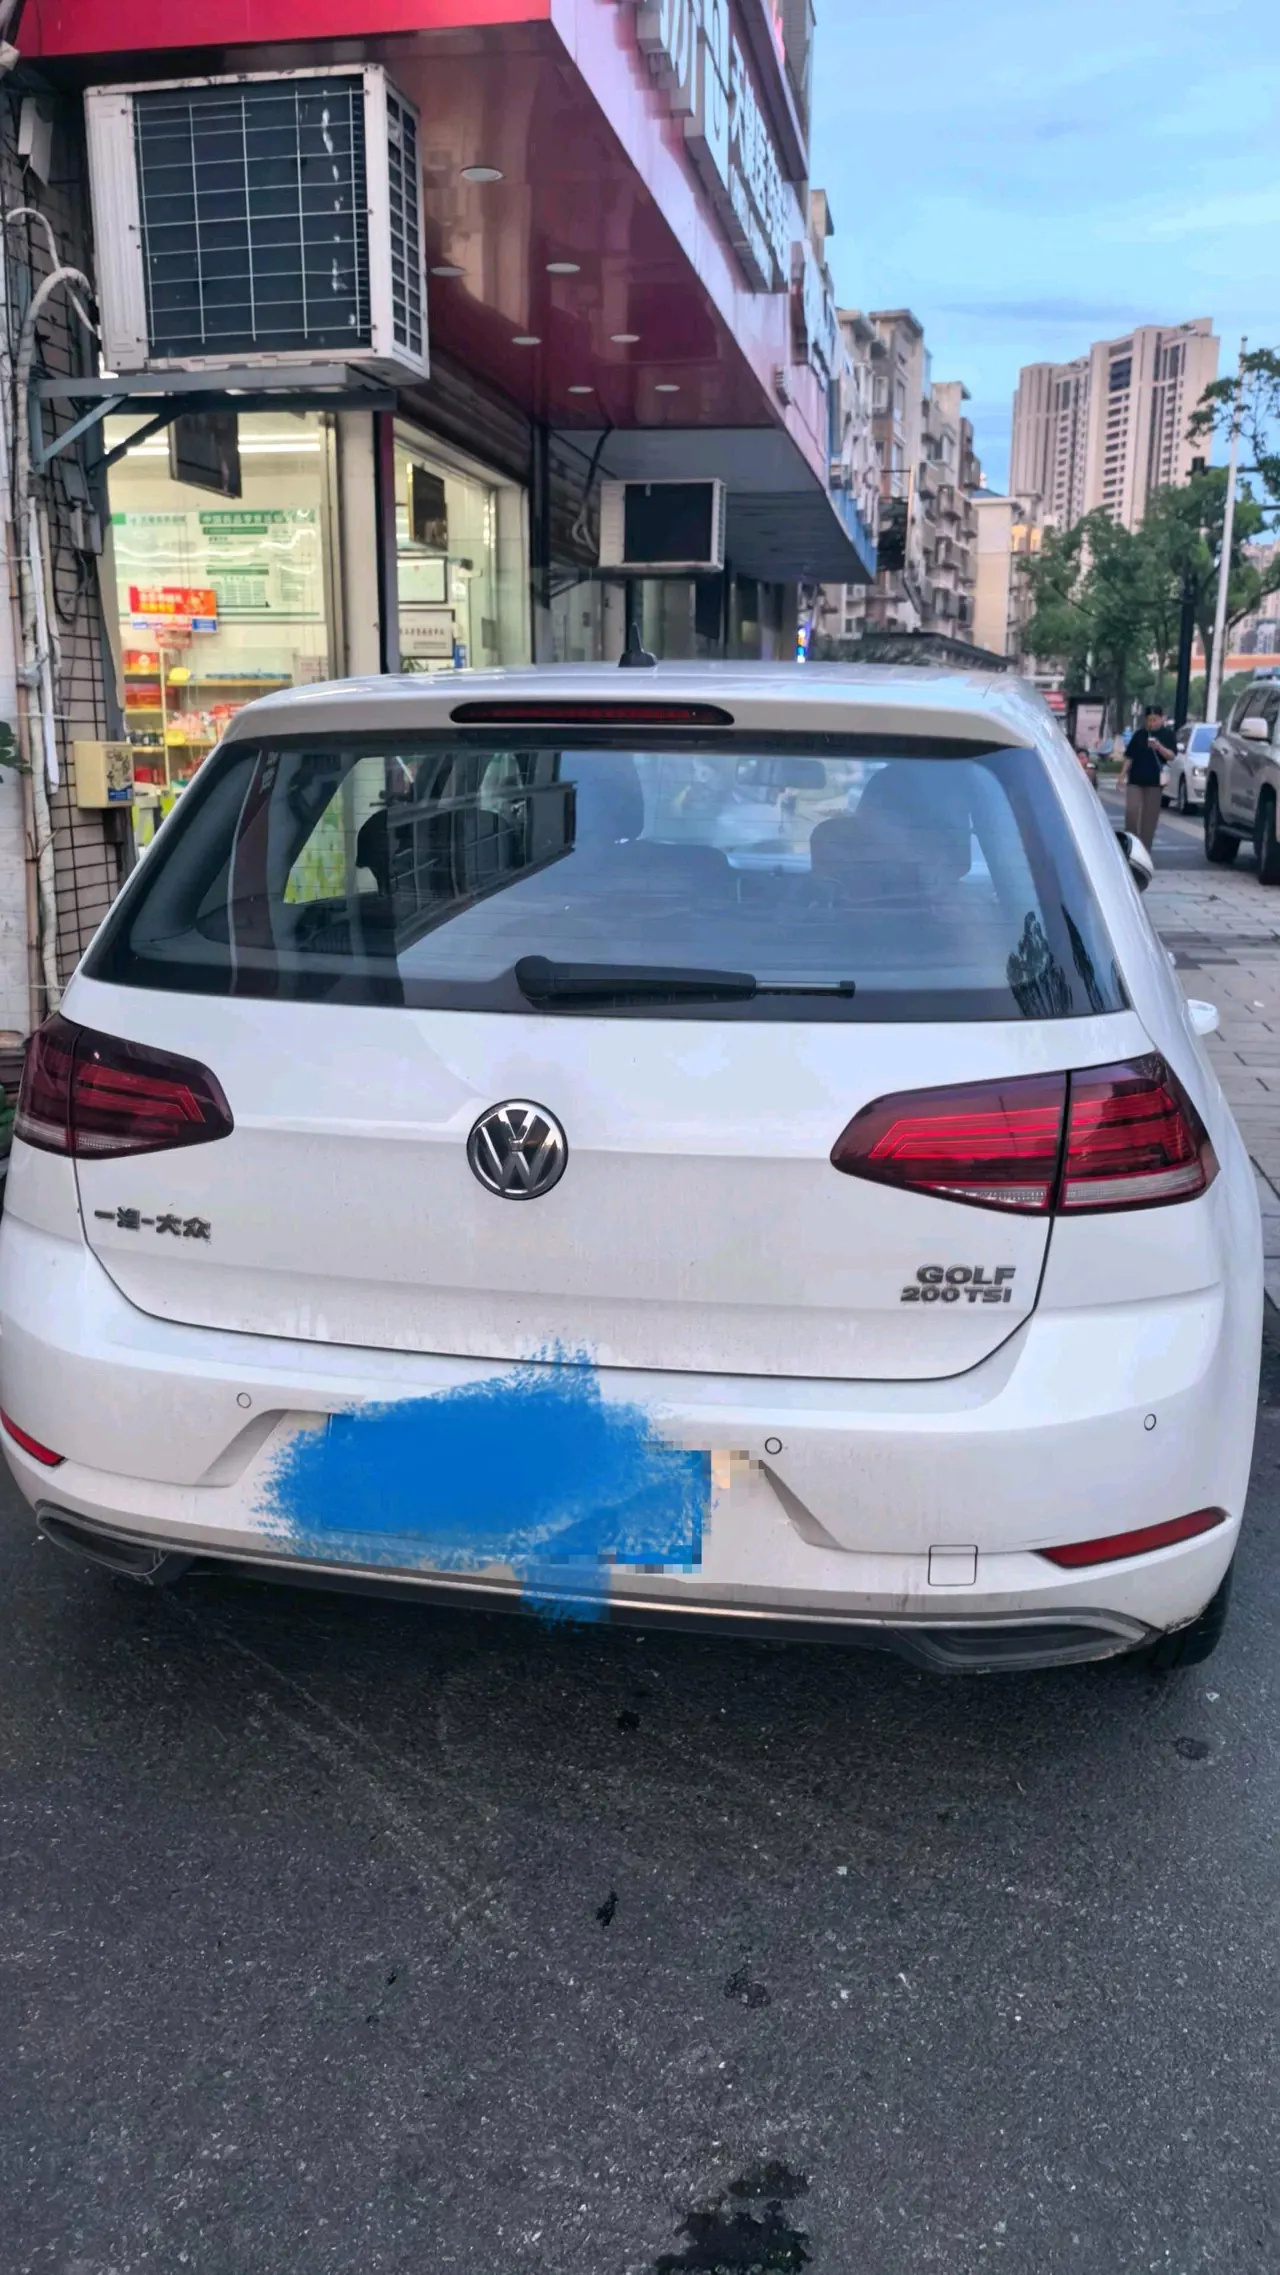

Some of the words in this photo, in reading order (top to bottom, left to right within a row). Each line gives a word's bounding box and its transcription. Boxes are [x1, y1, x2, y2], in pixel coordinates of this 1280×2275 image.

[916, 1264, 1016, 1285] GOLF
[900, 1285, 960, 1302] 200
[964, 1286, 1012, 1303] TSI
